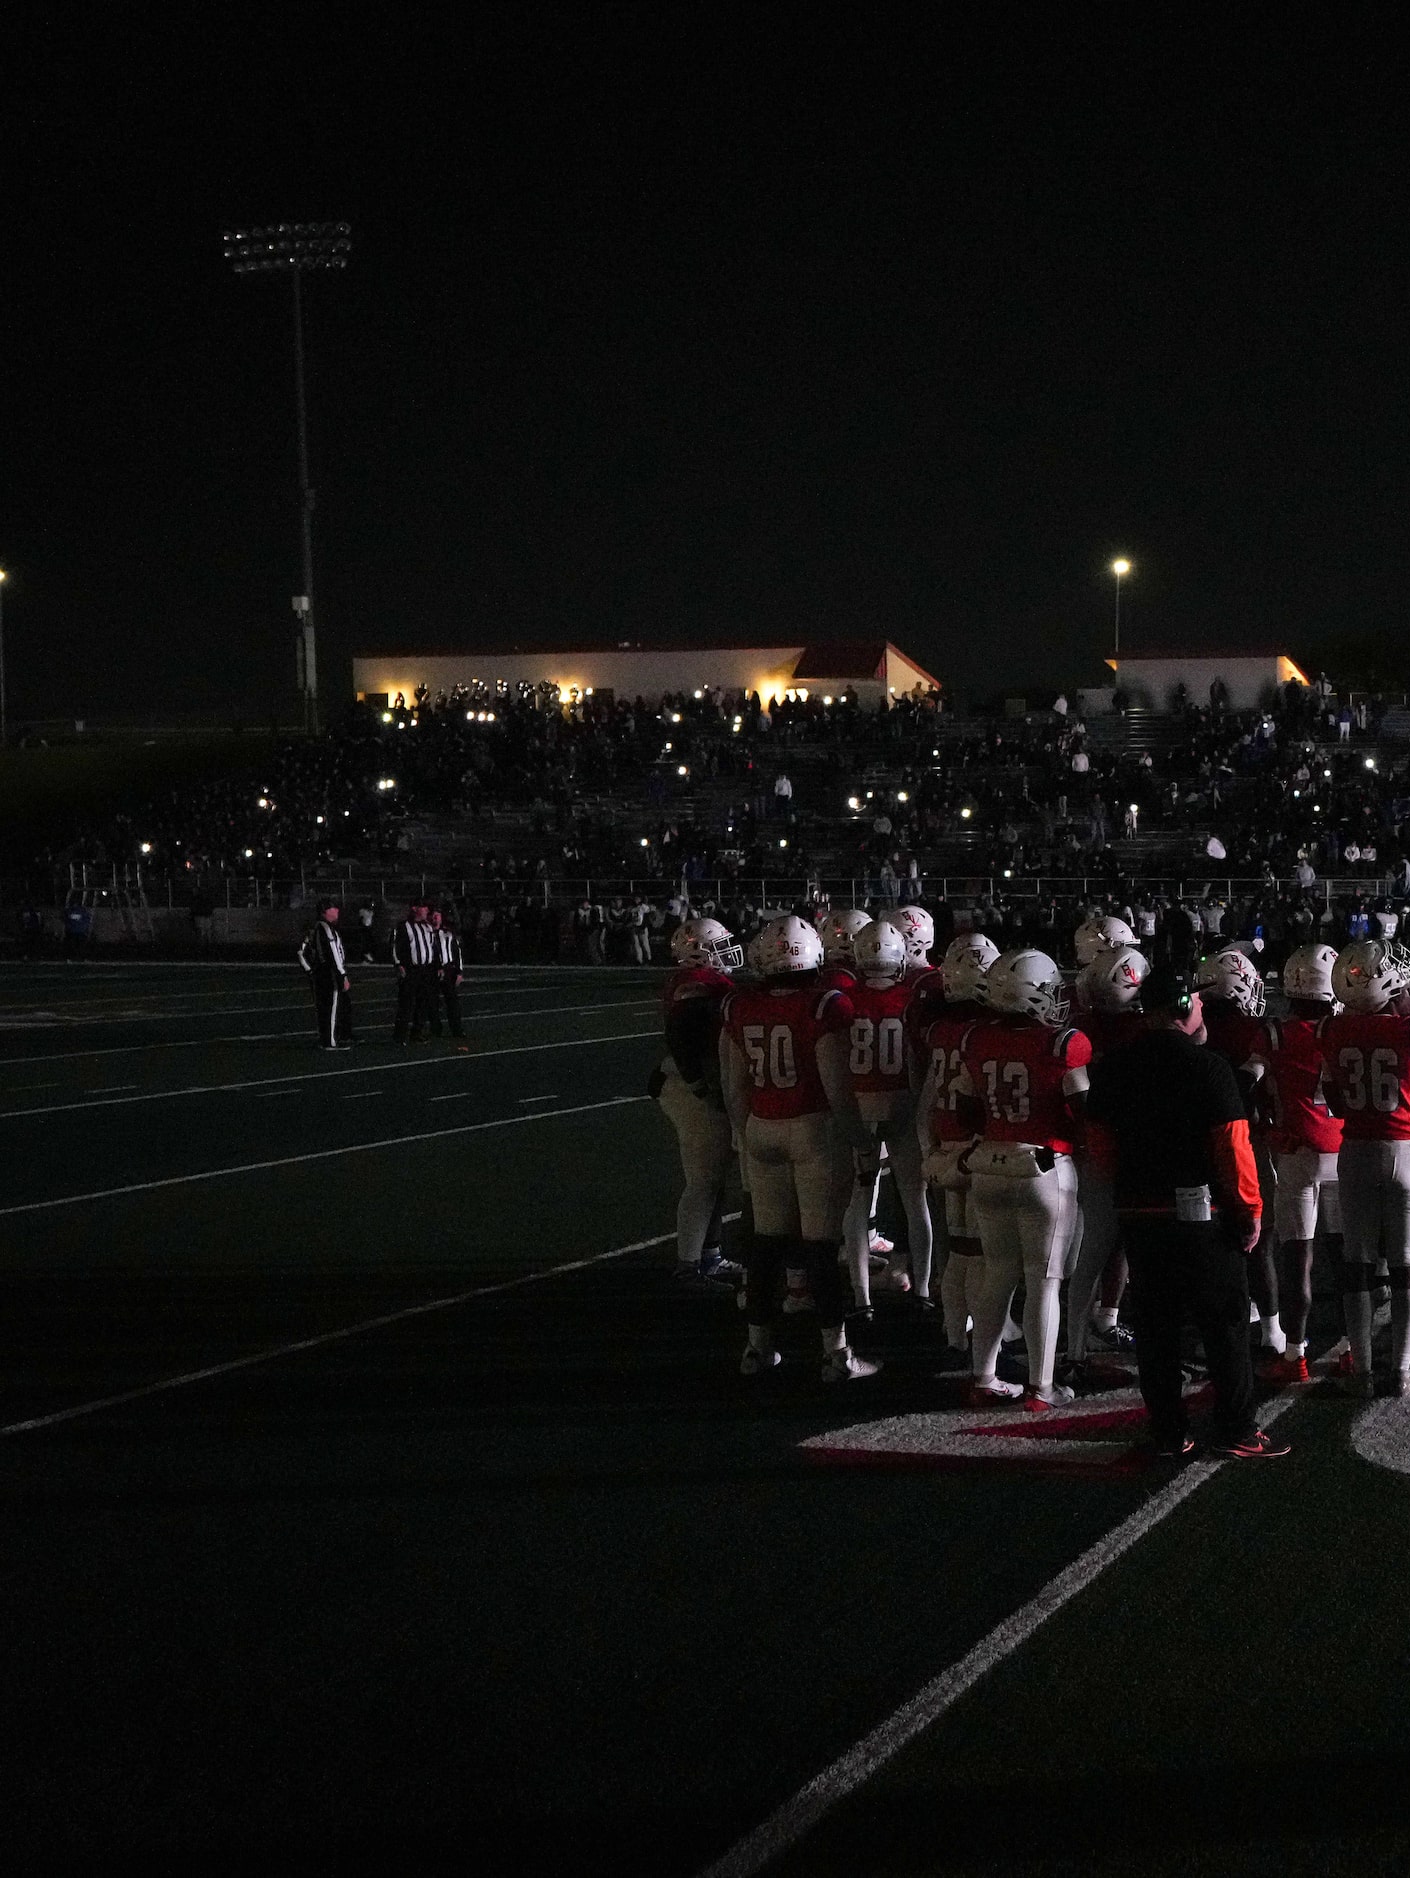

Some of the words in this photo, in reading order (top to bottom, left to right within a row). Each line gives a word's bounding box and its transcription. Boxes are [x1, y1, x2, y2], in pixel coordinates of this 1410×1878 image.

[742, 1023, 799, 1089] 50
[848, 1017, 904, 1076] 80
[1338, 1046, 1400, 1112] 36
[982, 1059, 1031, 1124] 13
